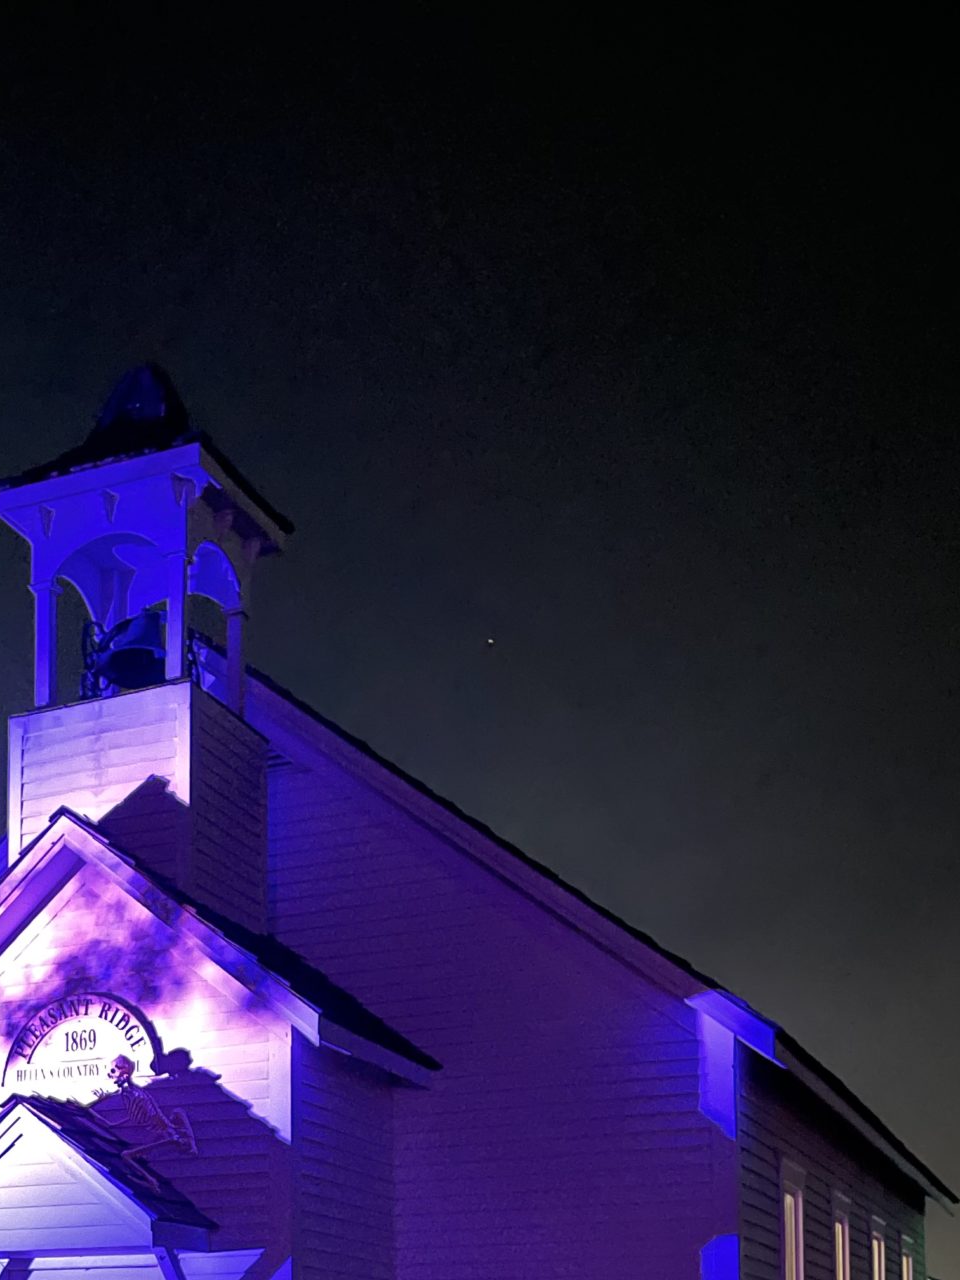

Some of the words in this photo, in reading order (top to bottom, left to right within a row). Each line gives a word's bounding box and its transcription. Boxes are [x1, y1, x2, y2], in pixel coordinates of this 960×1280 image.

[15, 998, 93, 1059] PLEASANT
[98, 1001, 146, 1052] RIDGE
[65, 1029, 97, 1052] 1869
[57, 1063, 100, 1080] COUNTRY
